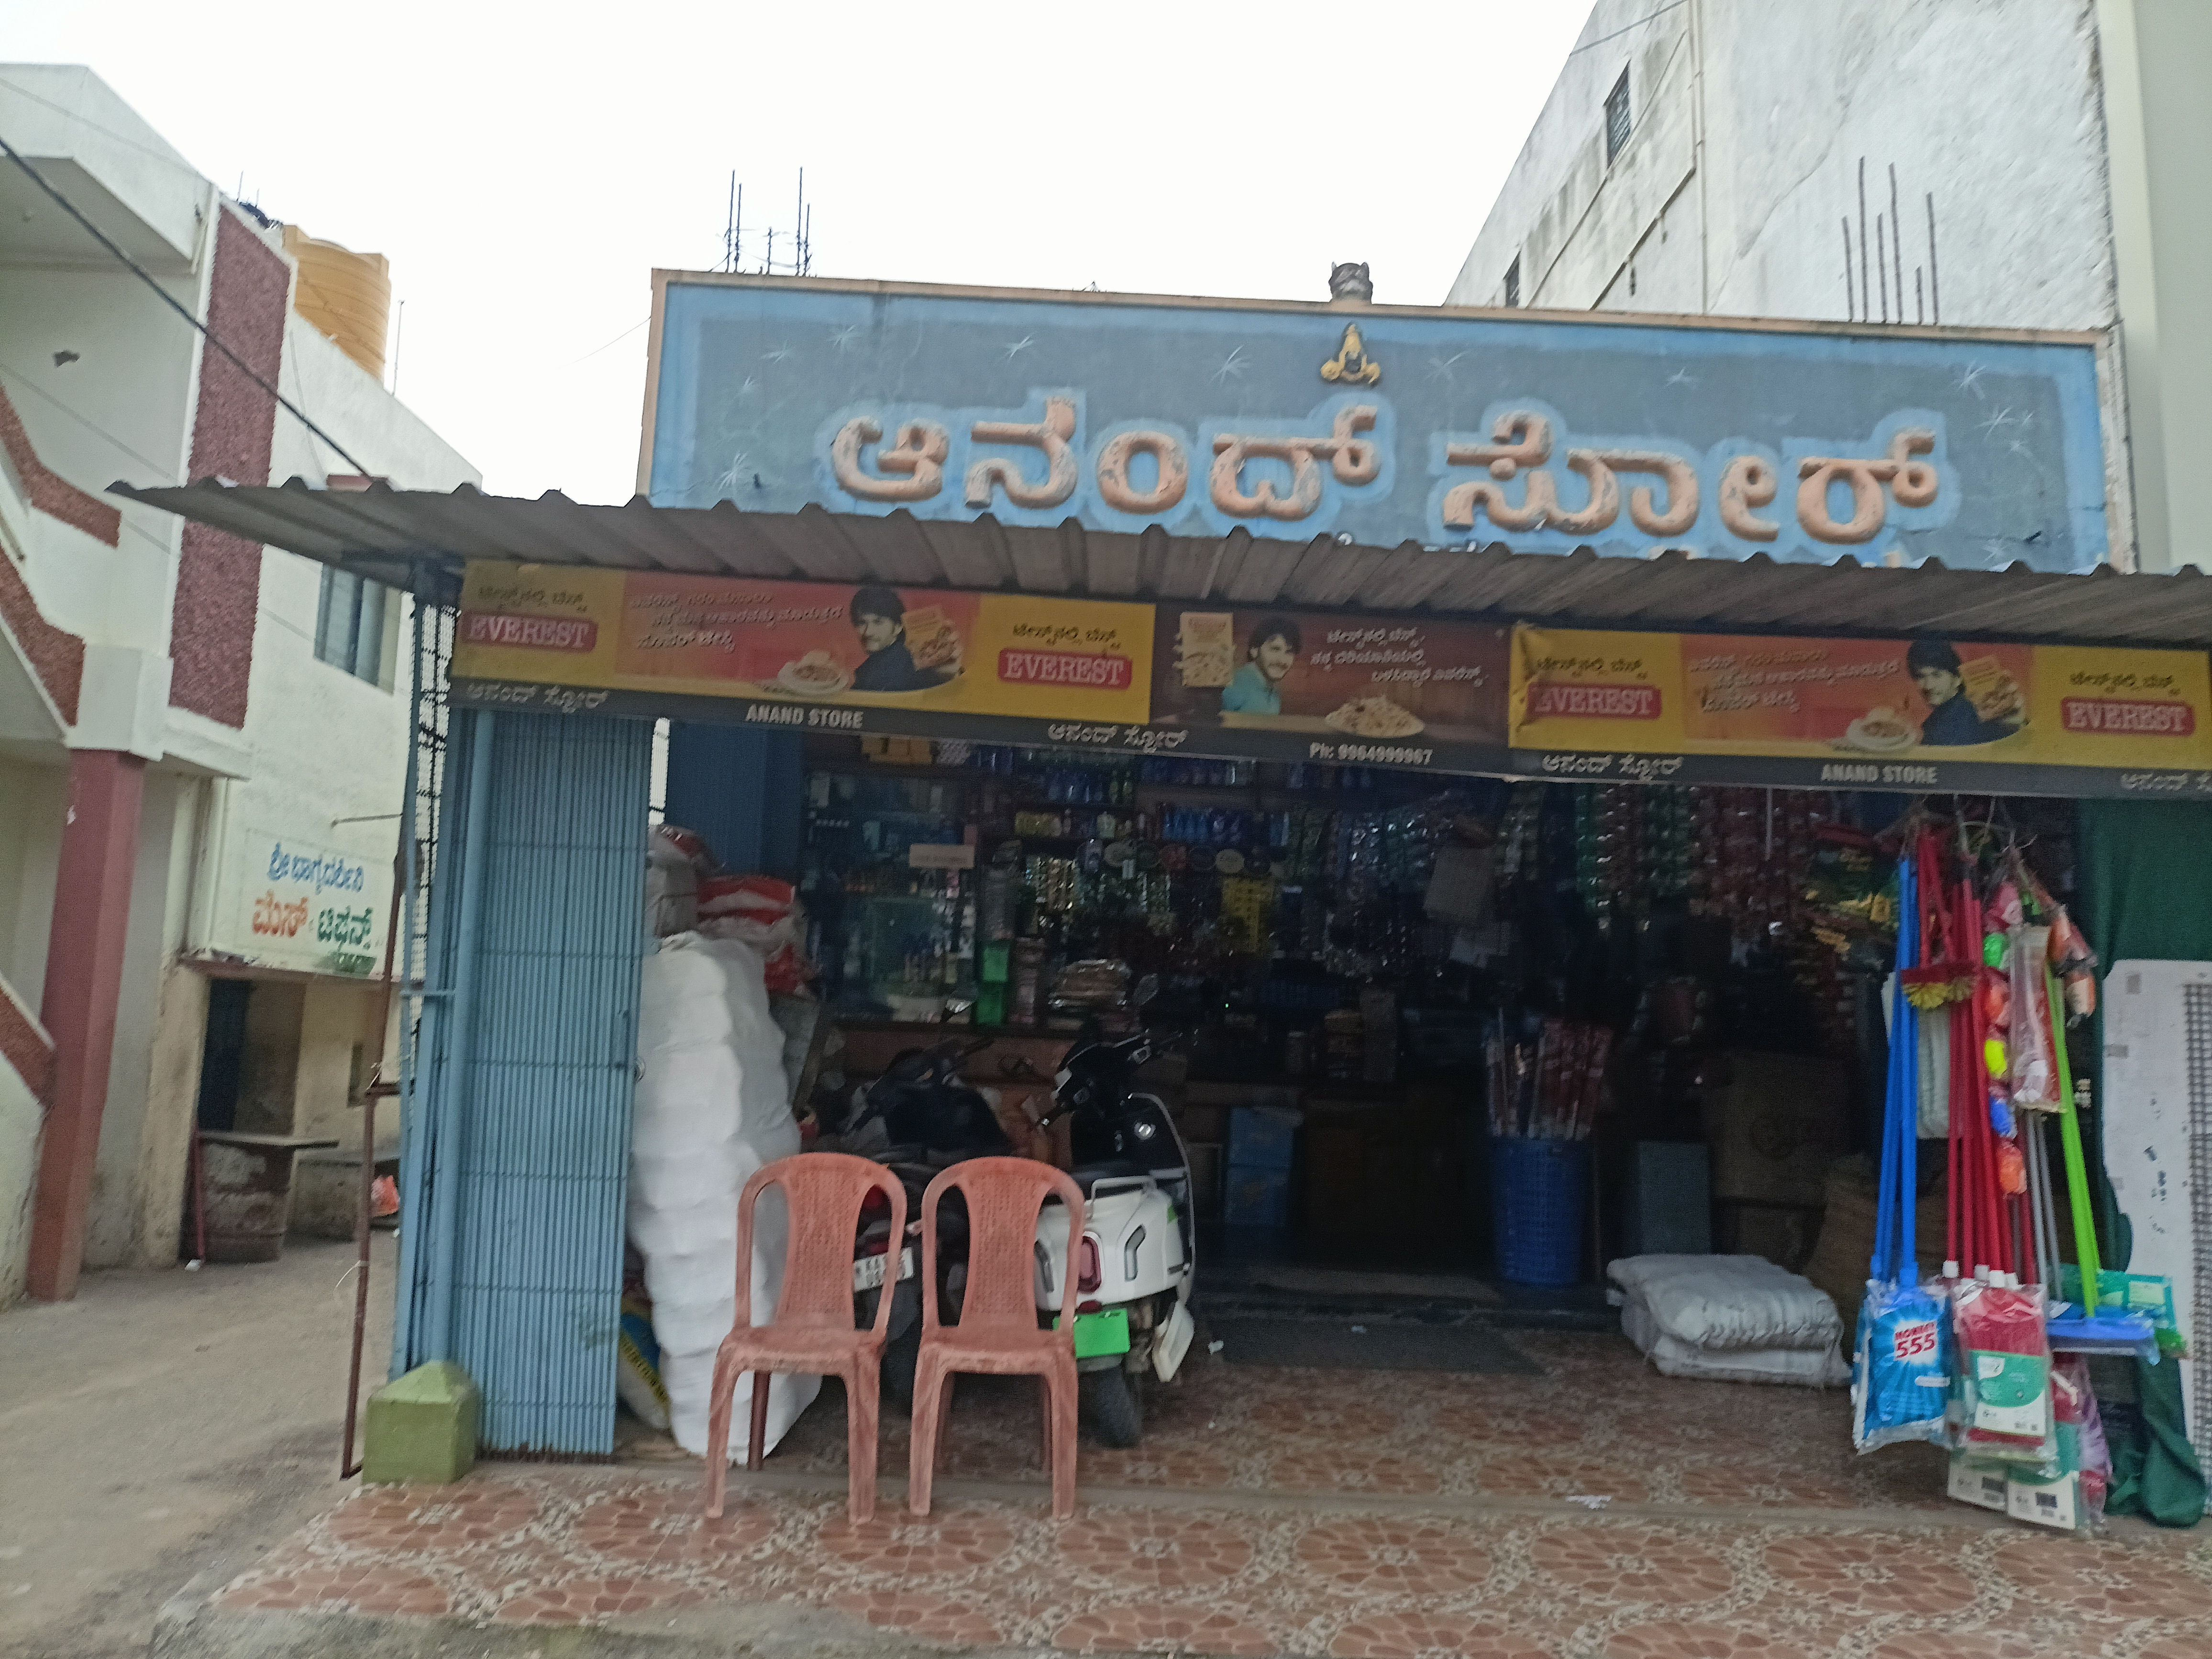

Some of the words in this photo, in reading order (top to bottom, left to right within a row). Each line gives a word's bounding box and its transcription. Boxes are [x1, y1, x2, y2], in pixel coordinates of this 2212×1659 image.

[831, 395, 1382, 521] ಆನಂದ್
[468, 614, 590, 649] EVEREST
[1004, 652, 1125, 686] EVEREST
[1534, 686, 1654, 715] EVEREST
[745, 703, 804, 725] ANAND
[807, 708, 864, 729] STORE
[2067, 701, 2188, 732] EVEREST
[1309, 741, 1334, 759] Ph:
[1820, 763, 1880, 783] ANAND
[1881, 765, 1938, 784] STORE
[1895, 1332, 1936, 1359] 555
